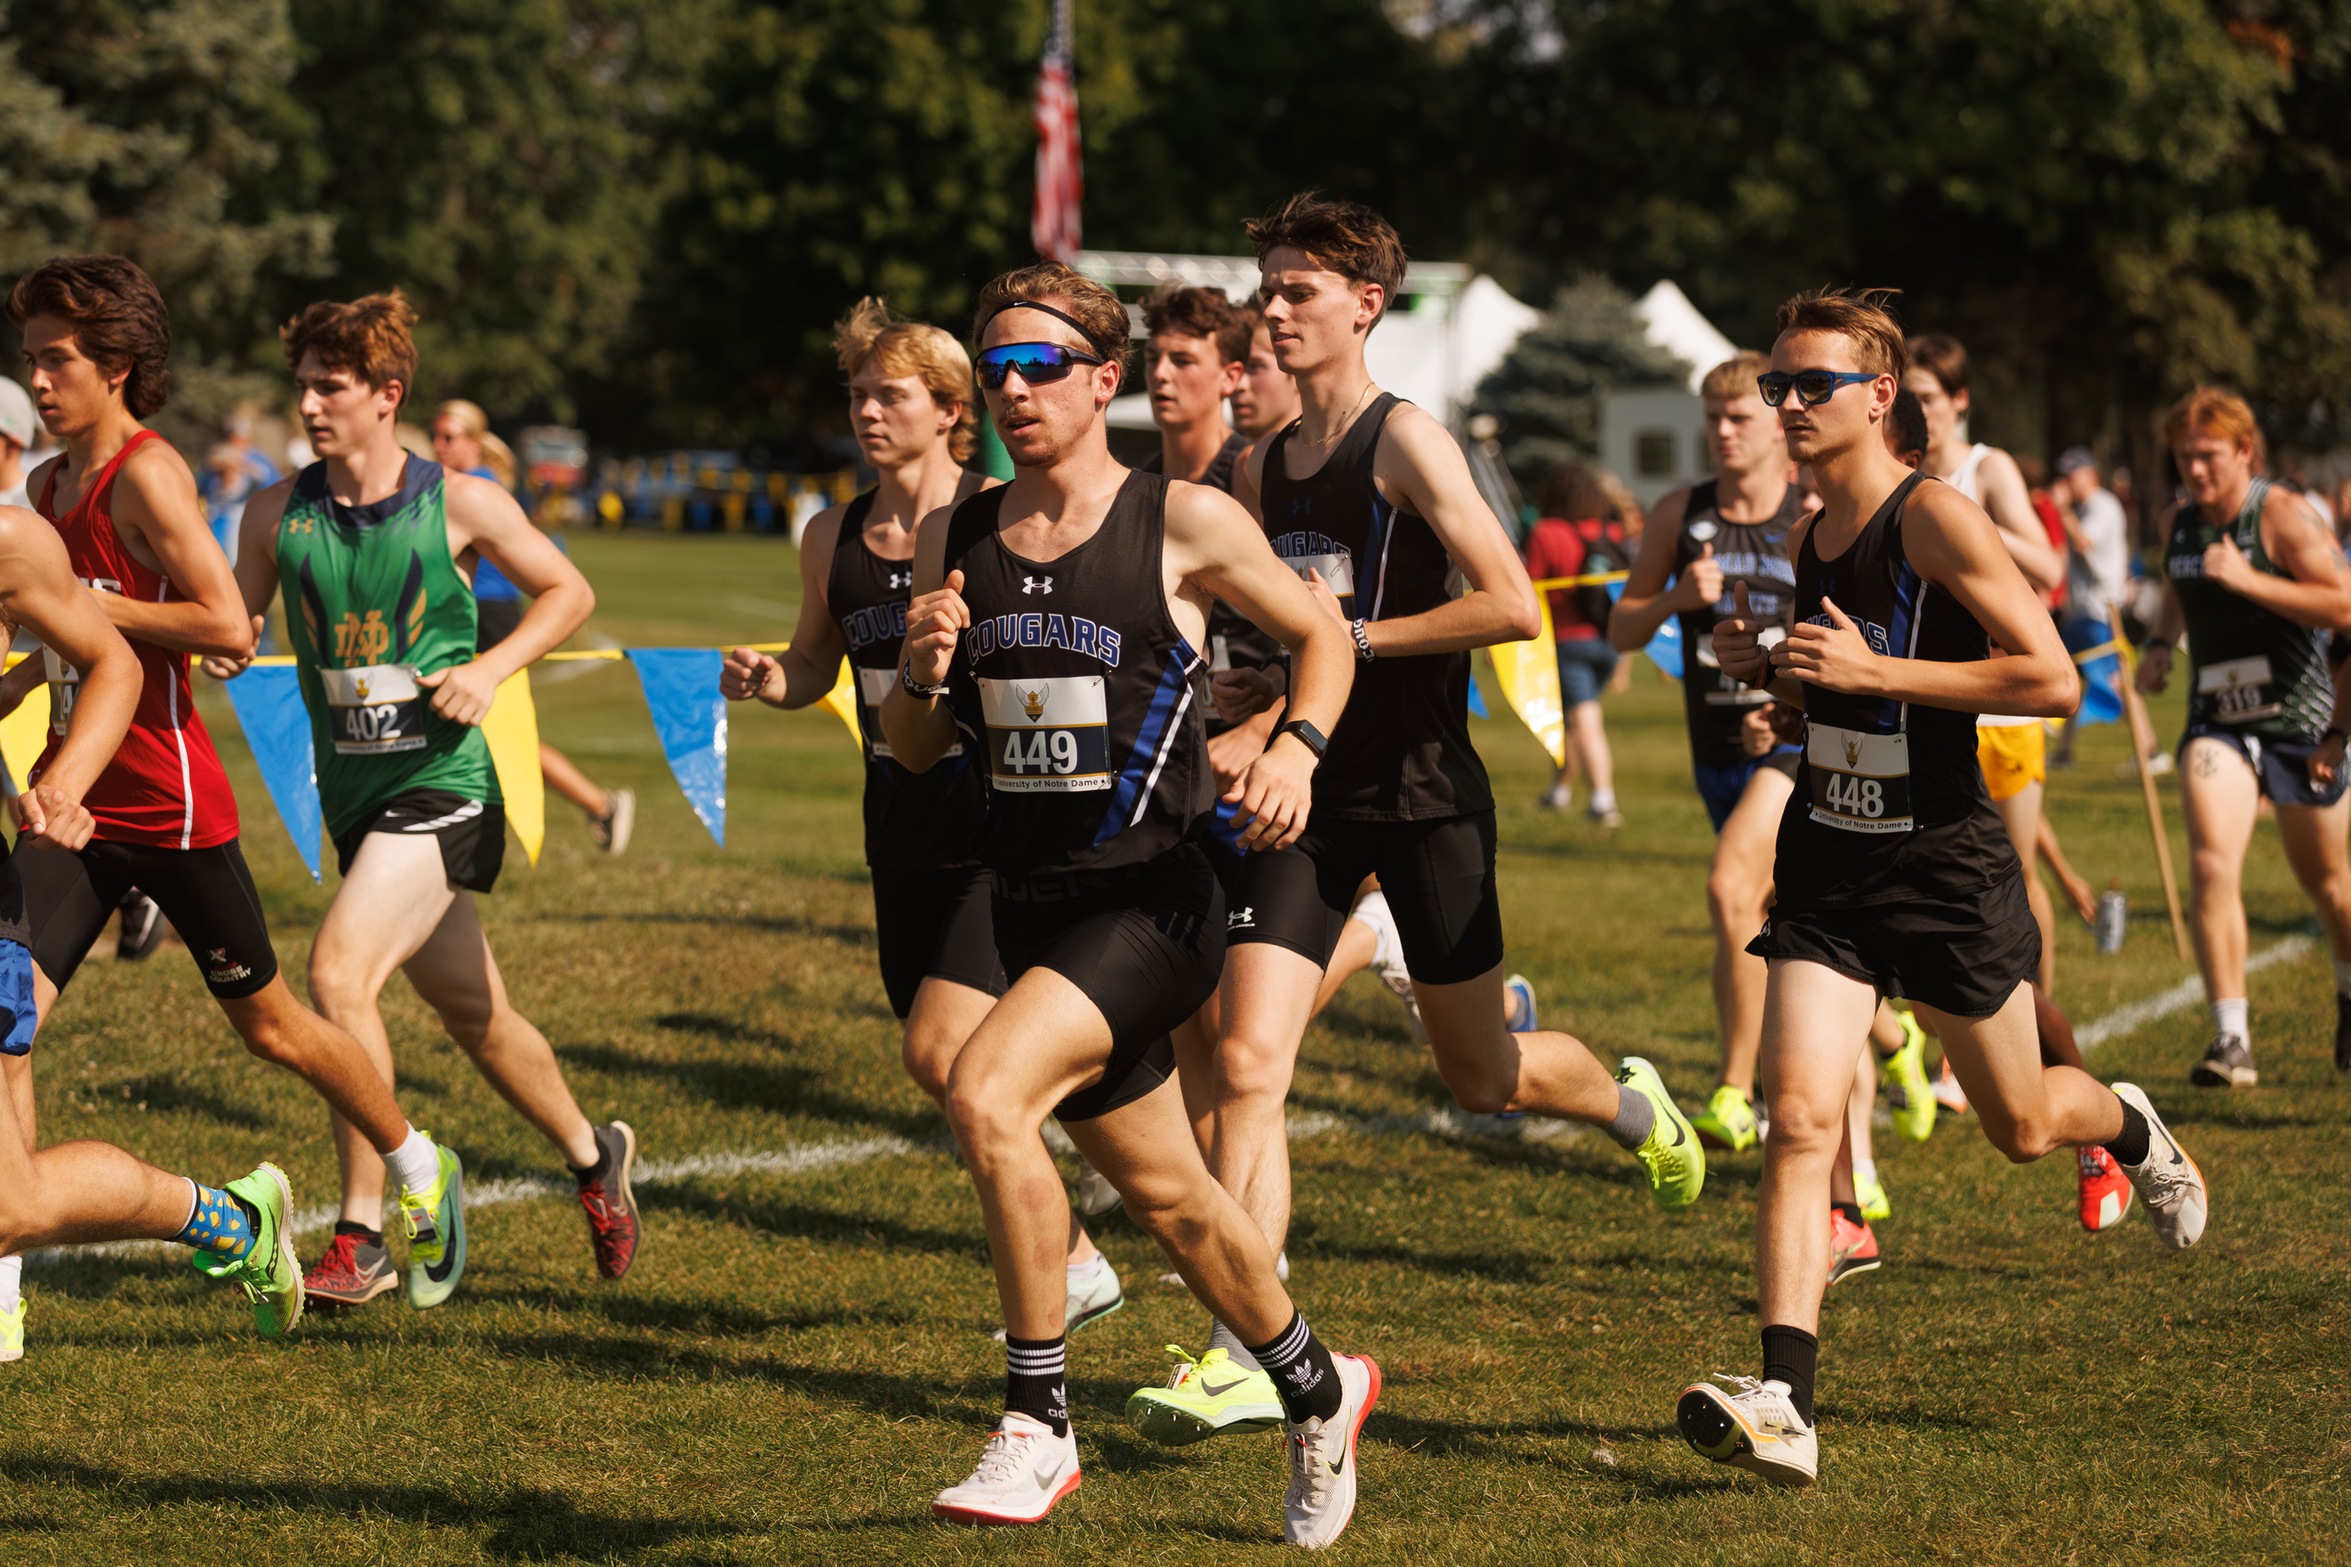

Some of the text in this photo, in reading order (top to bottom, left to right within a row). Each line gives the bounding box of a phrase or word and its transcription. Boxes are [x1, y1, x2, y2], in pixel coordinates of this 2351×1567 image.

[965, 613, 1121, 667] COUGARS
[346, 704, 401, 741] 402
[1003, 730, 1078, 774] 449
[1033, 780, 1041, 788] of
[1044, 780, 1068, 788] Notre
[1071, 779, 1098, 788] Dame
[1826, 773, 1884, 818] 448
[1818, 811, 1844, 826] University
[1854, 821, 1875, 829] Notre
[1878, 822, 1902, 830] Dame
[1290, 1368, 1324, 1398] adidas
[1048, 1408, 1069, 1419] ad
